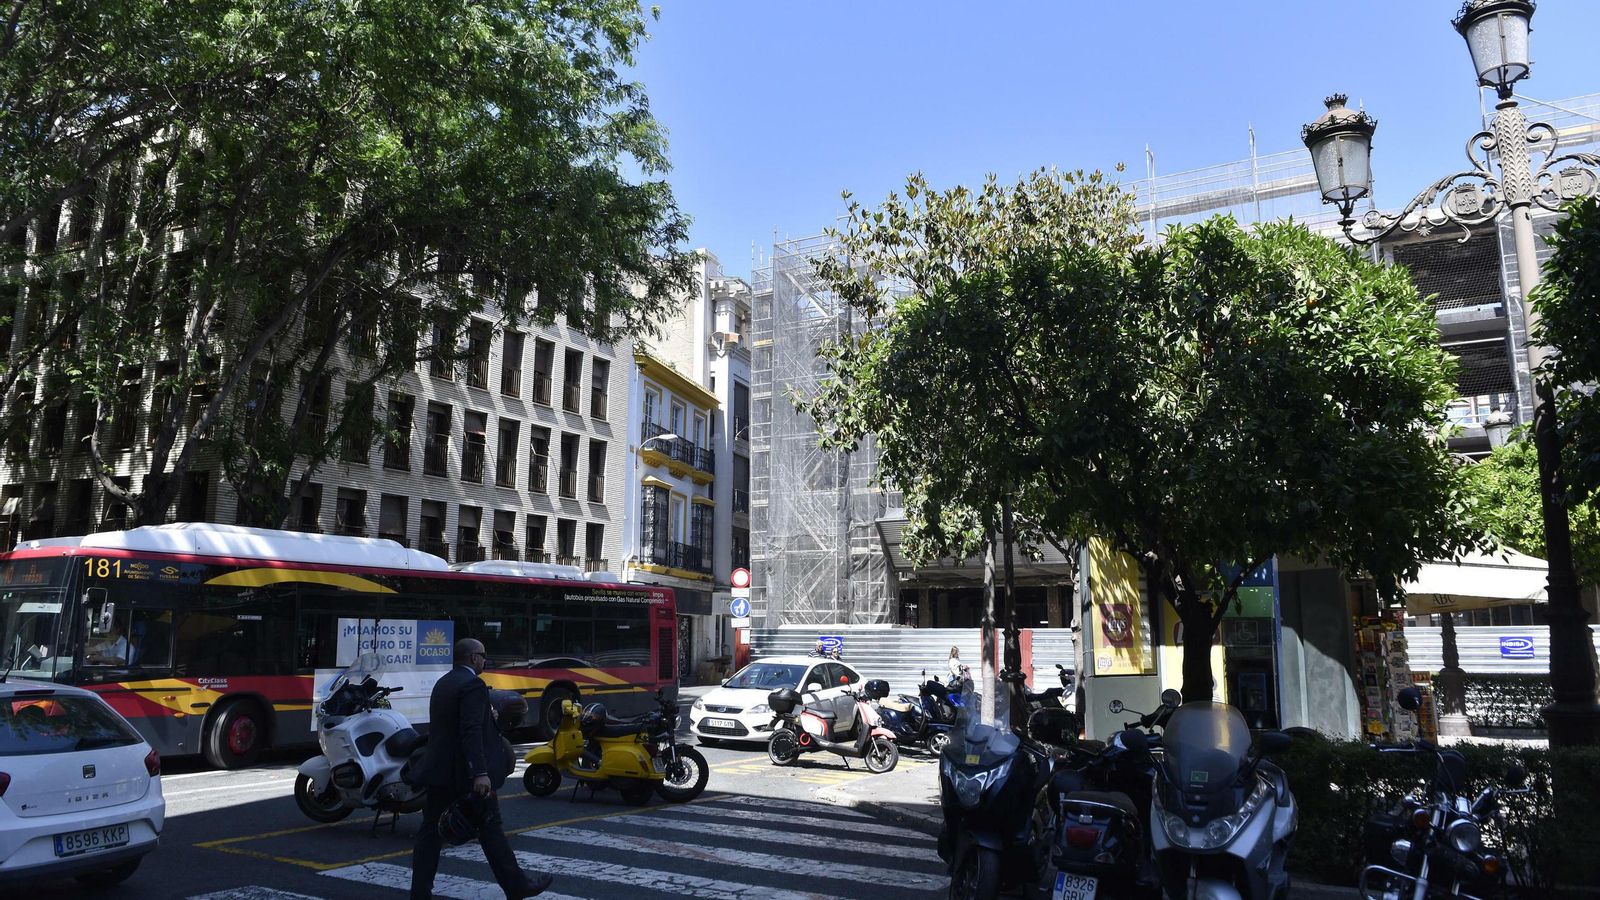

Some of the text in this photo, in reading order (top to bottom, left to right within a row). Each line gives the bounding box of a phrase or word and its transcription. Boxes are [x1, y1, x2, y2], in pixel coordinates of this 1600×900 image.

[84, 557, 121, 578] 181
[1432, 593, 1456, 605] ABC
[398, 626, 413, 635] SU
[398, 640, 413, 649] DE
[419, 647, 451, 657] OCASO
[67, 792, 109, 803] IBIZA
[66, 826, 125, 850] 8596 KKP
[1065, 875, 1095, 892] 8326
